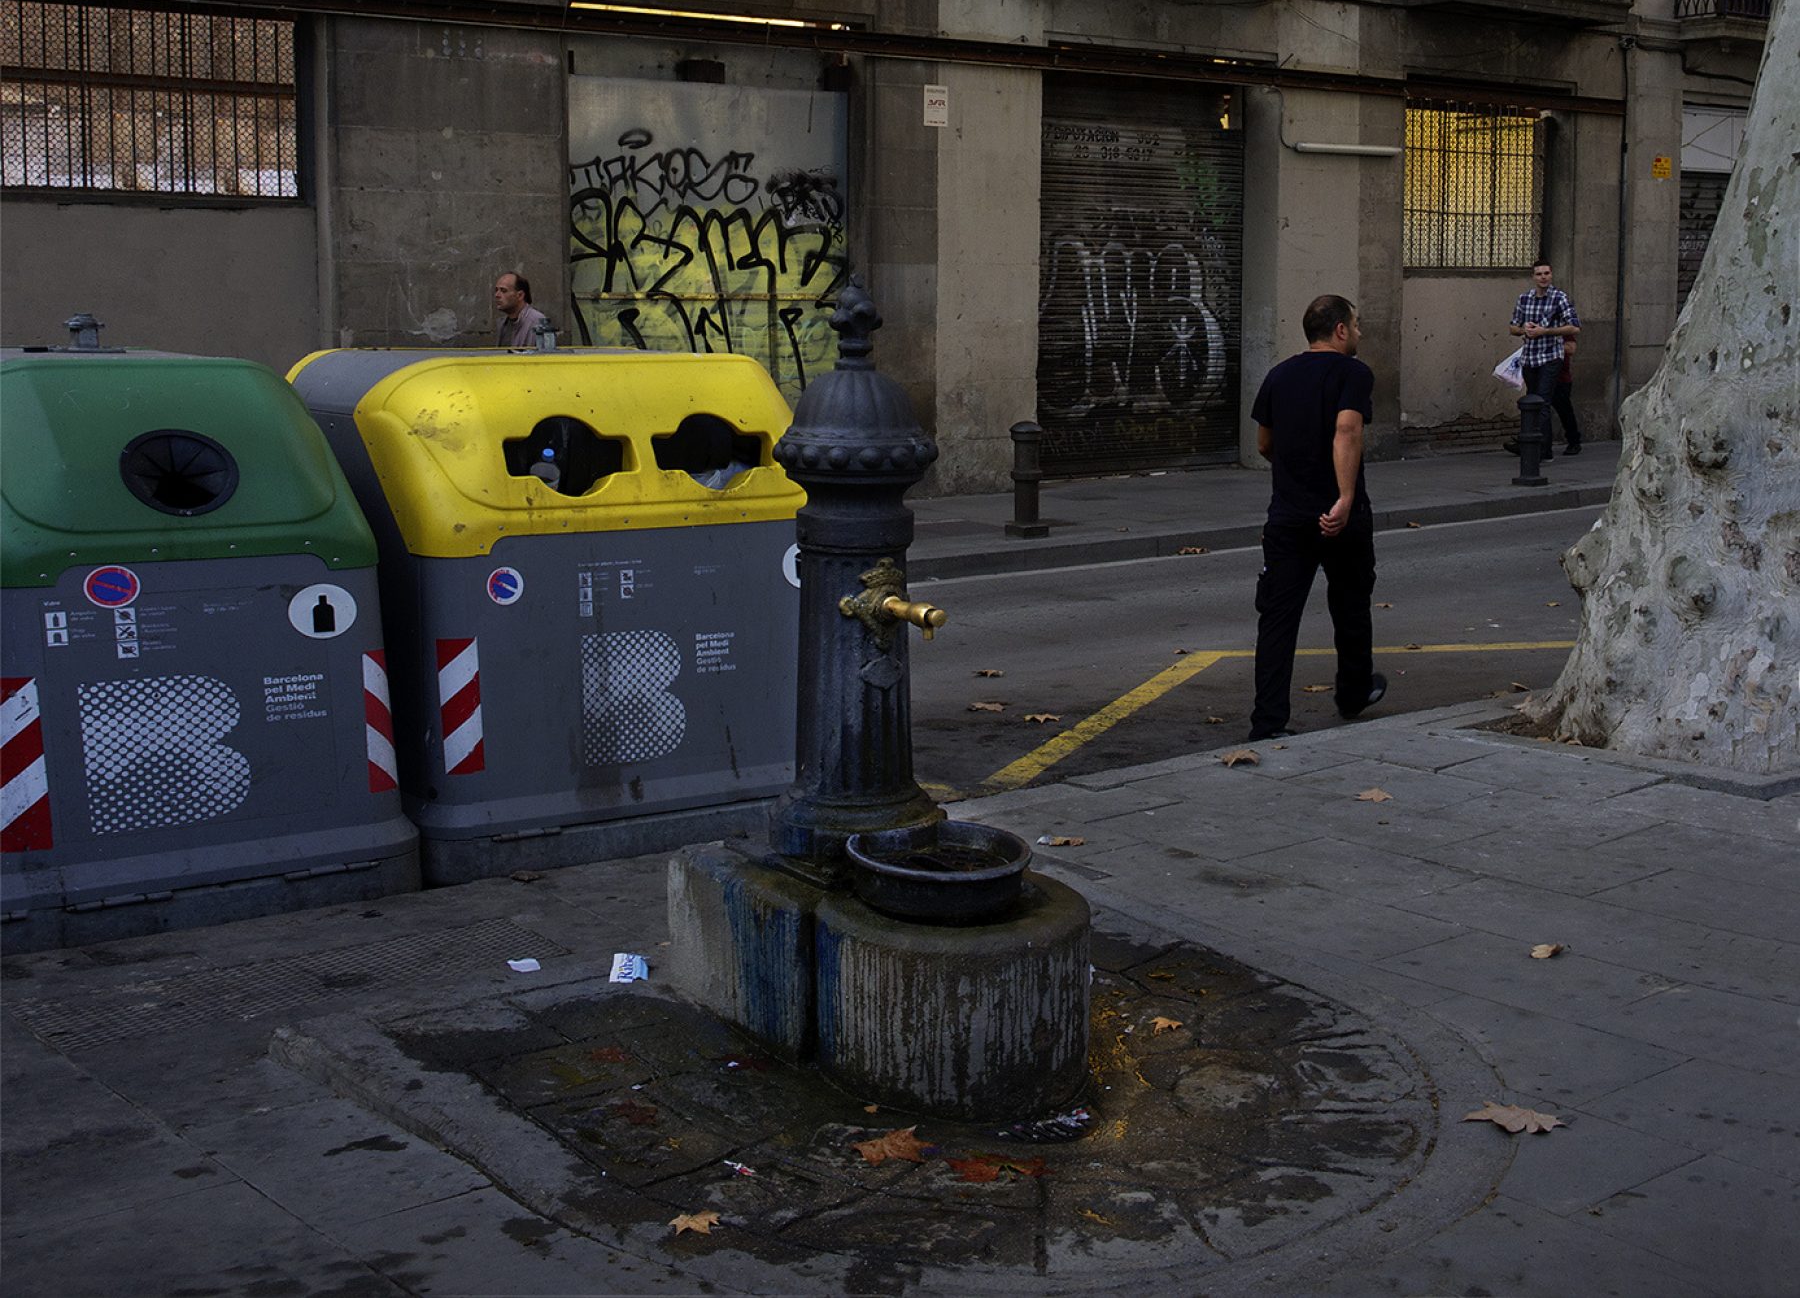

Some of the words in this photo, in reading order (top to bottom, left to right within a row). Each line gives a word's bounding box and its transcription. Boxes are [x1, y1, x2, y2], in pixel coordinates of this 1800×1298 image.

[695, 631, 735, 641] Barcelona
[263, 673, 324, 685] Barcelona
[264, 684, 283, 696] pel
[286, 682, 316, 693] Medi
[265, 692, 317, 704] Ambient
[266, 713, 282, 722] de
[284, 709, 328, 720] residus
